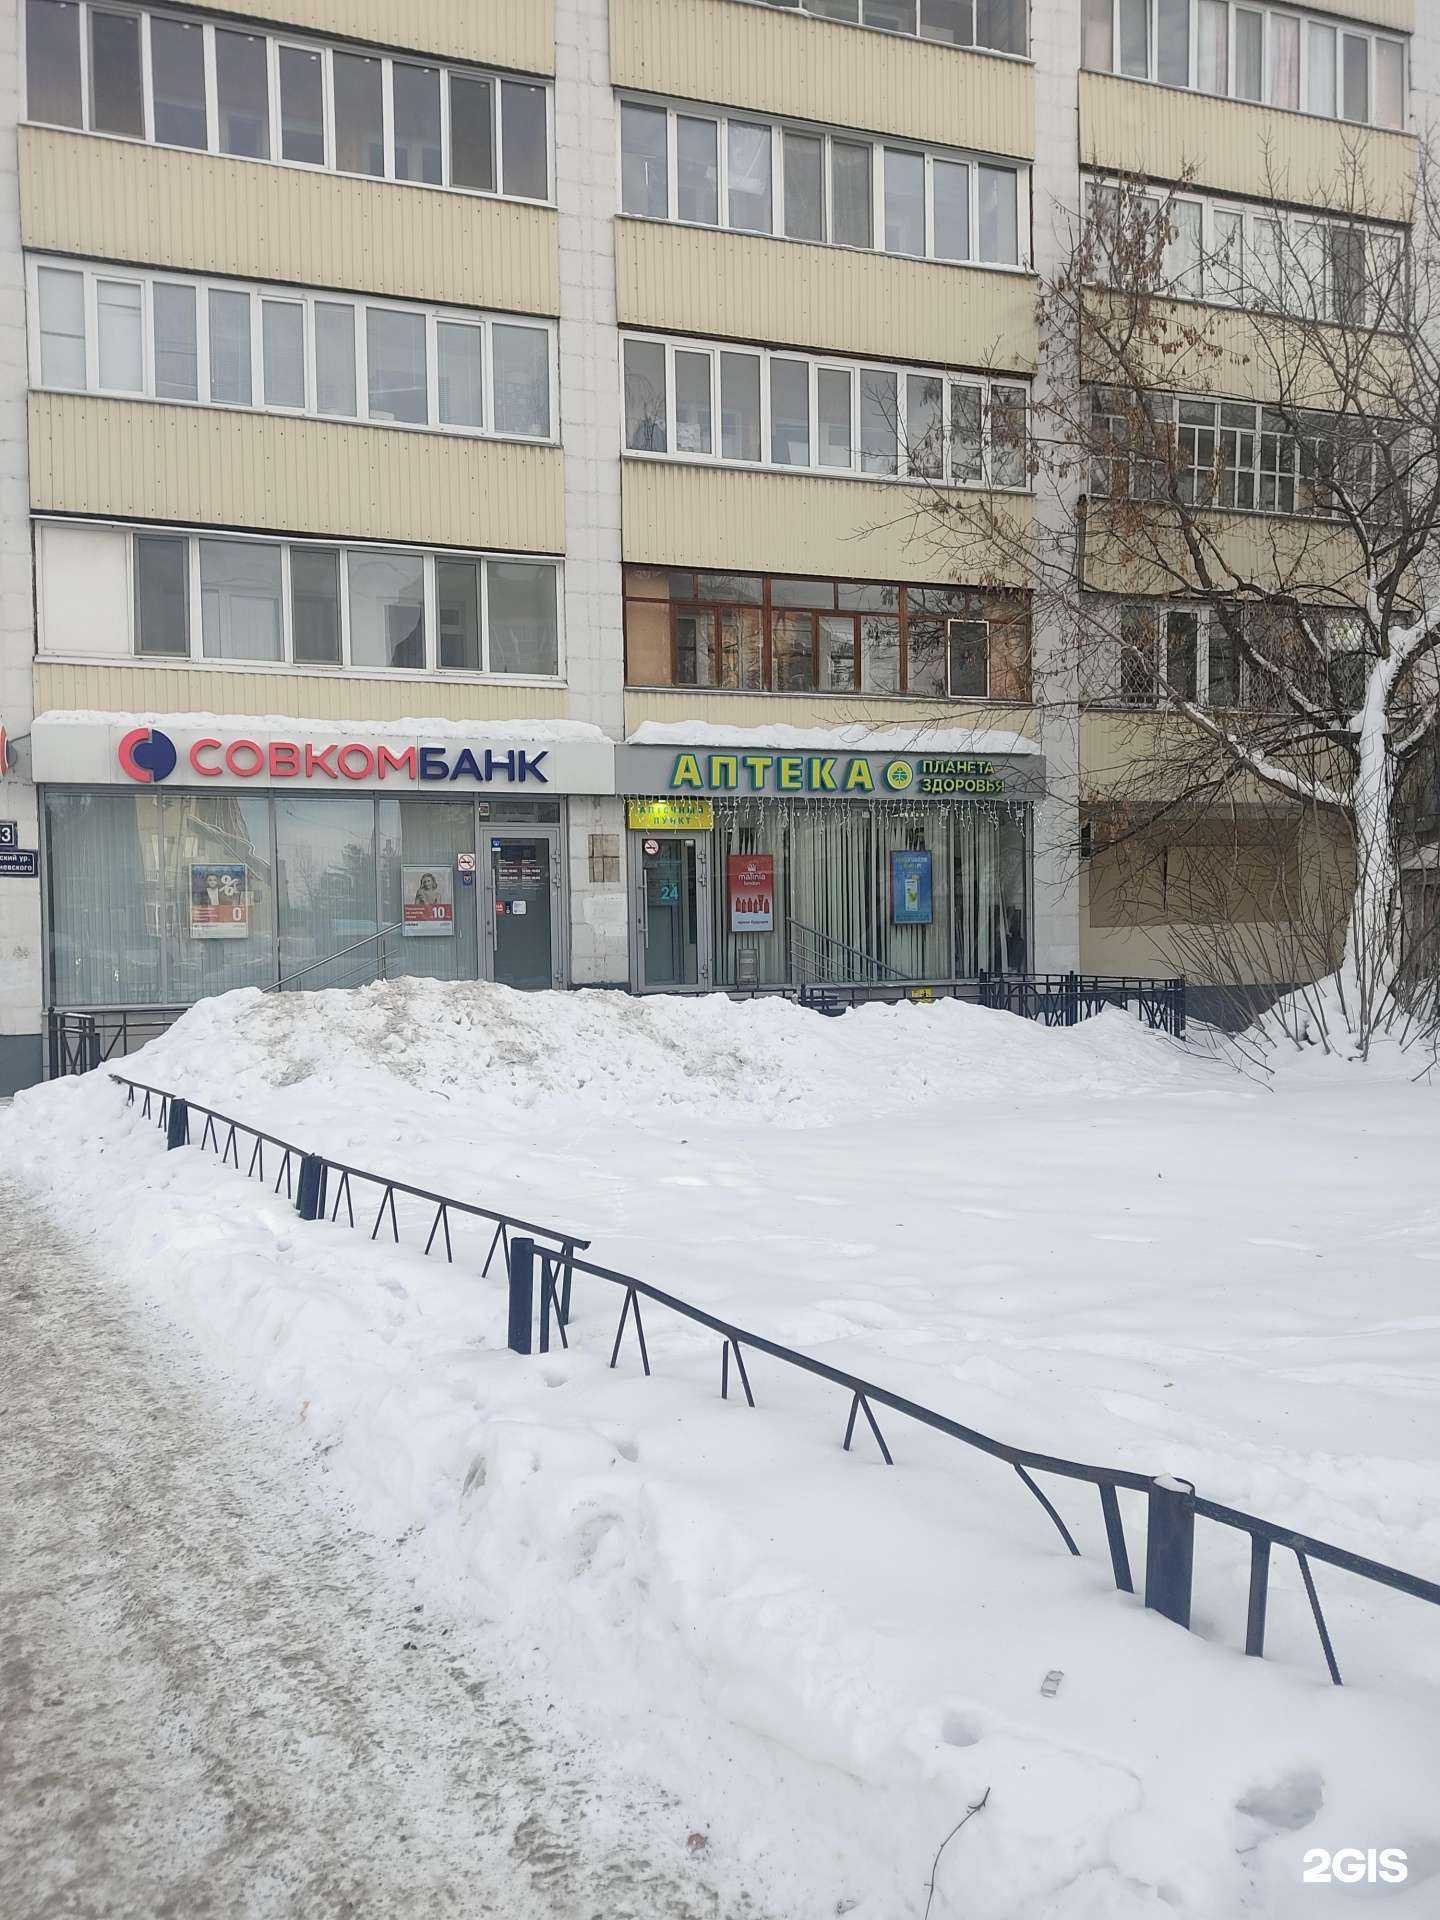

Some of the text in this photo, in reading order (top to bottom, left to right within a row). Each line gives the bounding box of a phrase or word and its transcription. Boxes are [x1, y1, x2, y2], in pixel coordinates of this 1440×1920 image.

[189, 738, 550, 783] СОВКОМБАНК
[921, 759, 996, 774] ПЛАНЕТА
[671, 753, 874, 792] АПТЕКА
[921, 778, 1005, 793] ЗДОРОВЬЯ
[661, 885, 679, 900] 24
[432, 906, 445, 919] 10
